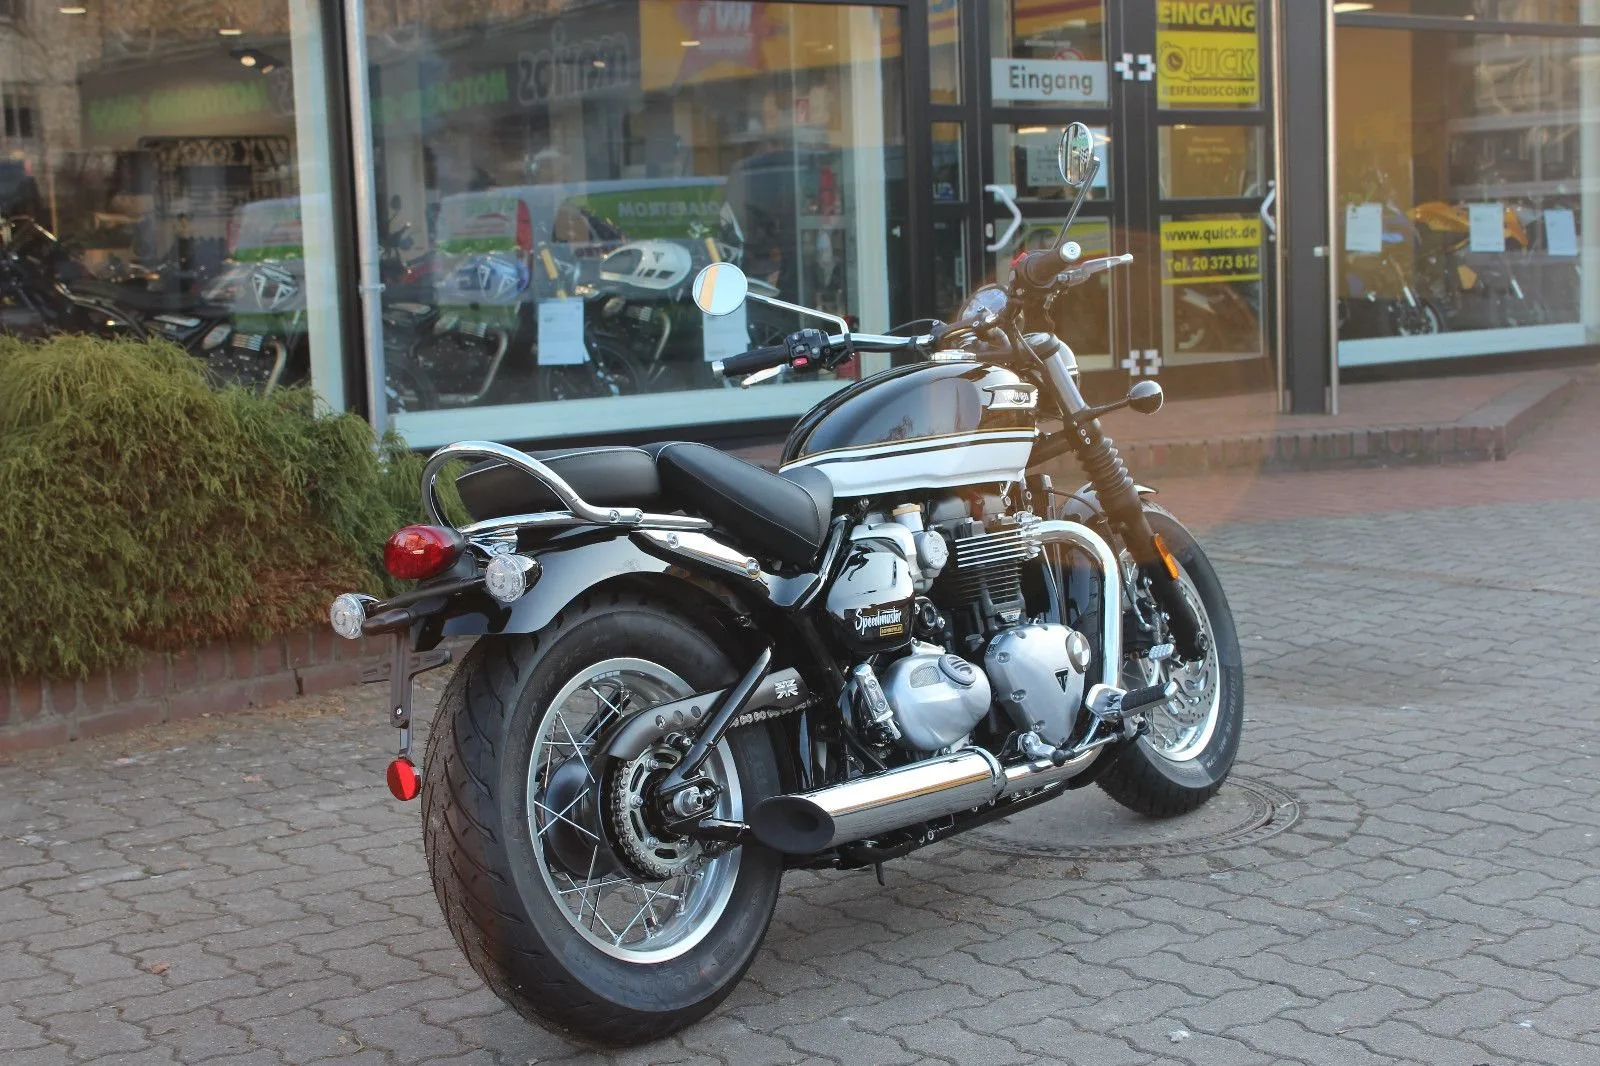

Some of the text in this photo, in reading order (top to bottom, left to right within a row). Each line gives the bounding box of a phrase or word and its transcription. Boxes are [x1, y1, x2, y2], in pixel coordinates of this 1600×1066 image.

[1157, 0, 1256, 28] EINGANG
[1159, 41, 1256, 82] QUICK
[1009, 64, 1093, 95] Eingang
[1165, 226, 1257, 244] www.quick.de
[1167, 257, 1191, 273] Tel.
[855, 606, 902, 635] Speedmaster
